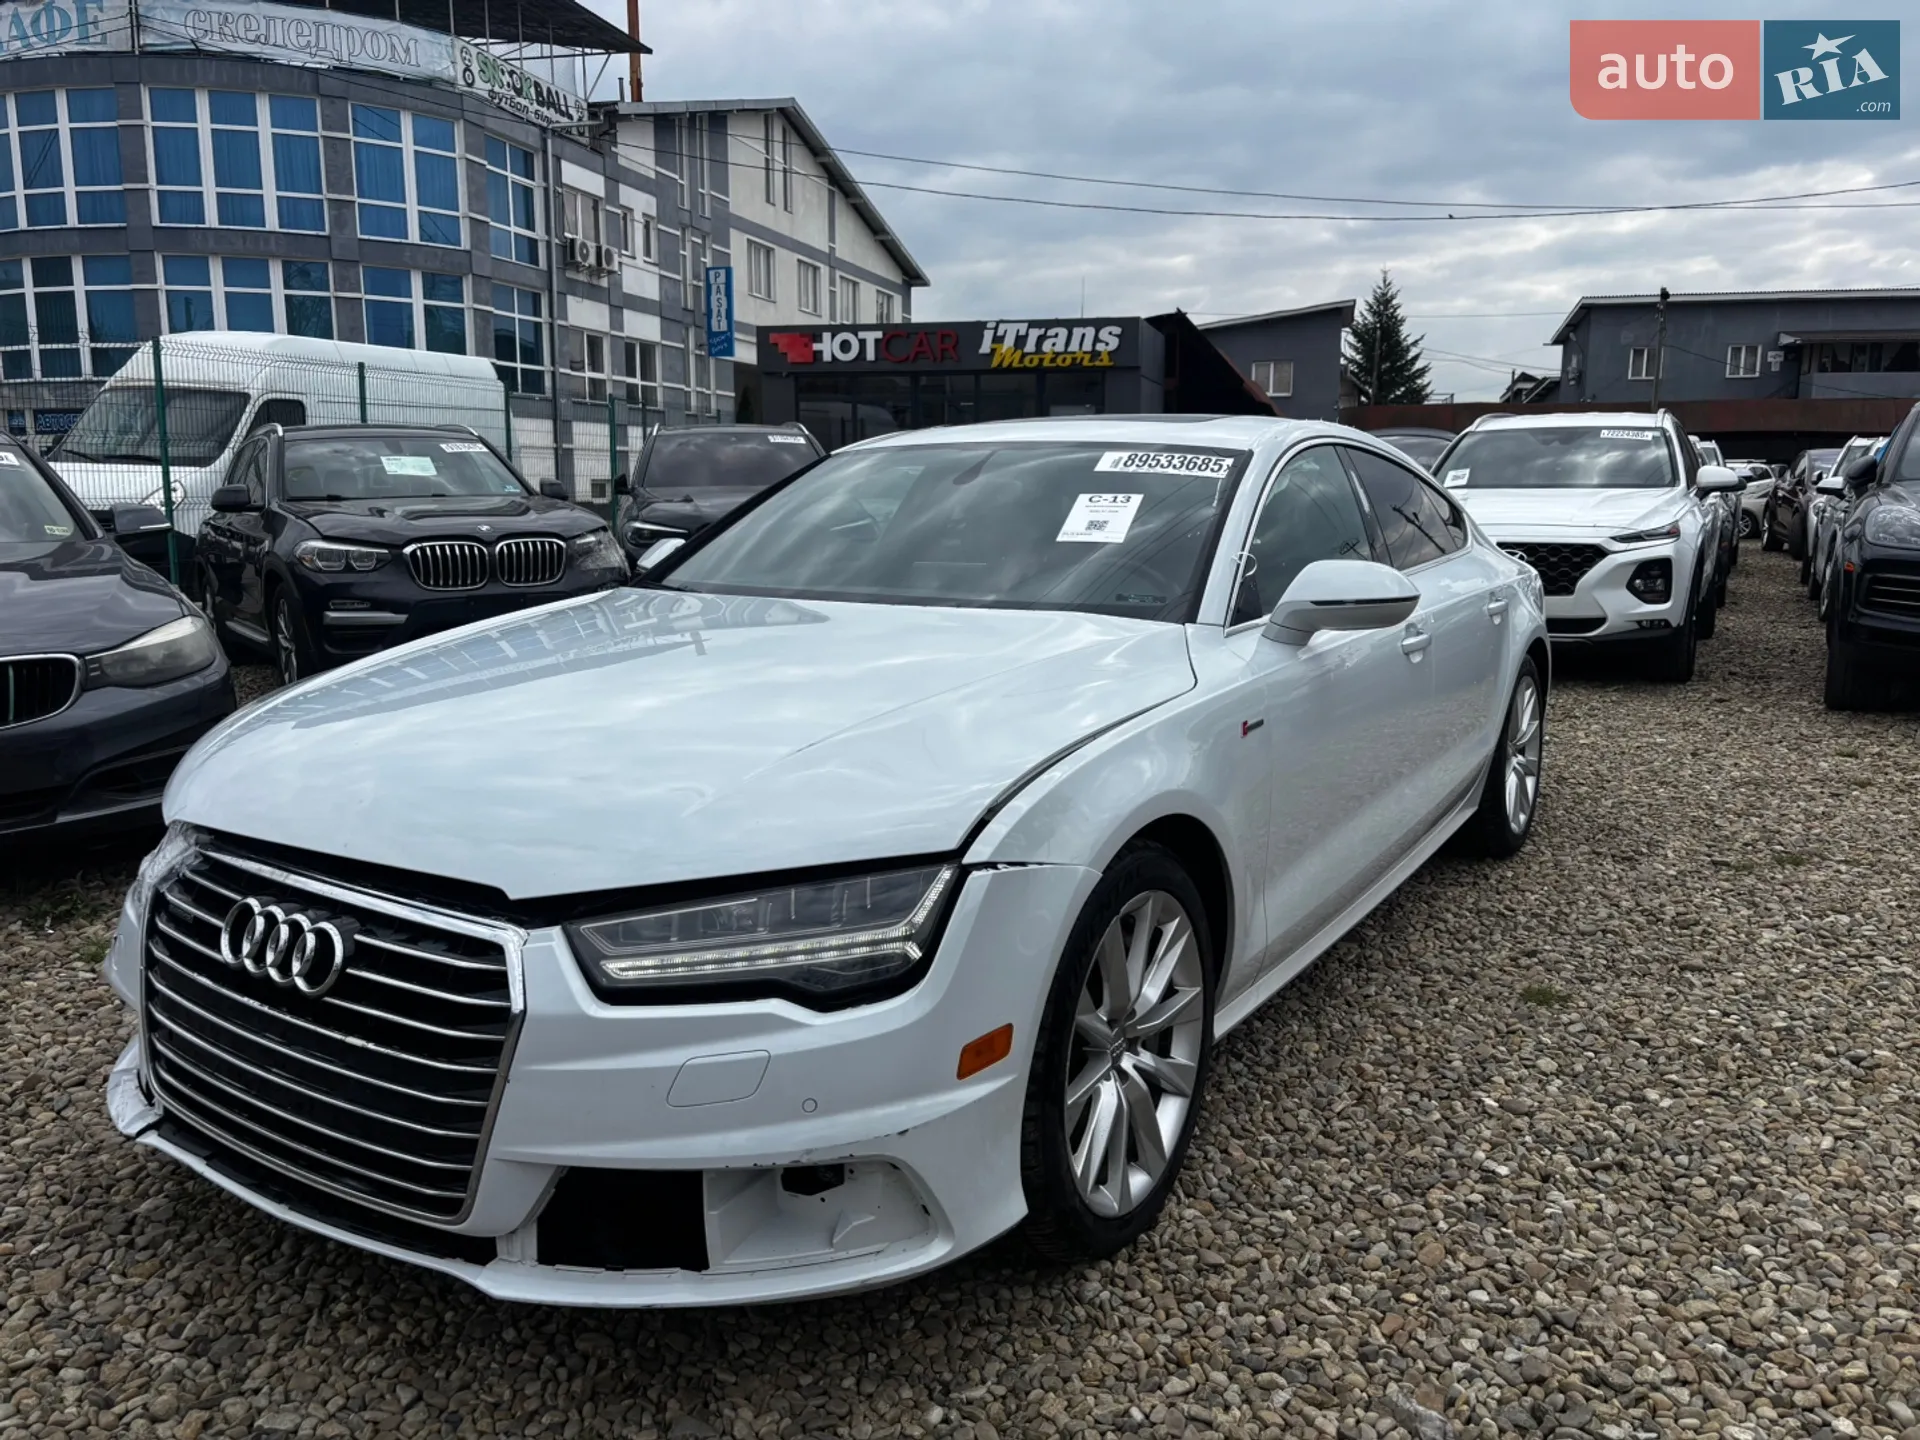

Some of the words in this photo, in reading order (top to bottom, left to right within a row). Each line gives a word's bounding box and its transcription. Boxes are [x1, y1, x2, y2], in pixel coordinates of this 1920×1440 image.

[0, 0, 108, 54] АФЕ
[978, 321, 1122, 354] iTrans
[990, 343, 1115, 369] Motors
[1088, 494, 1132, 503] C-13
